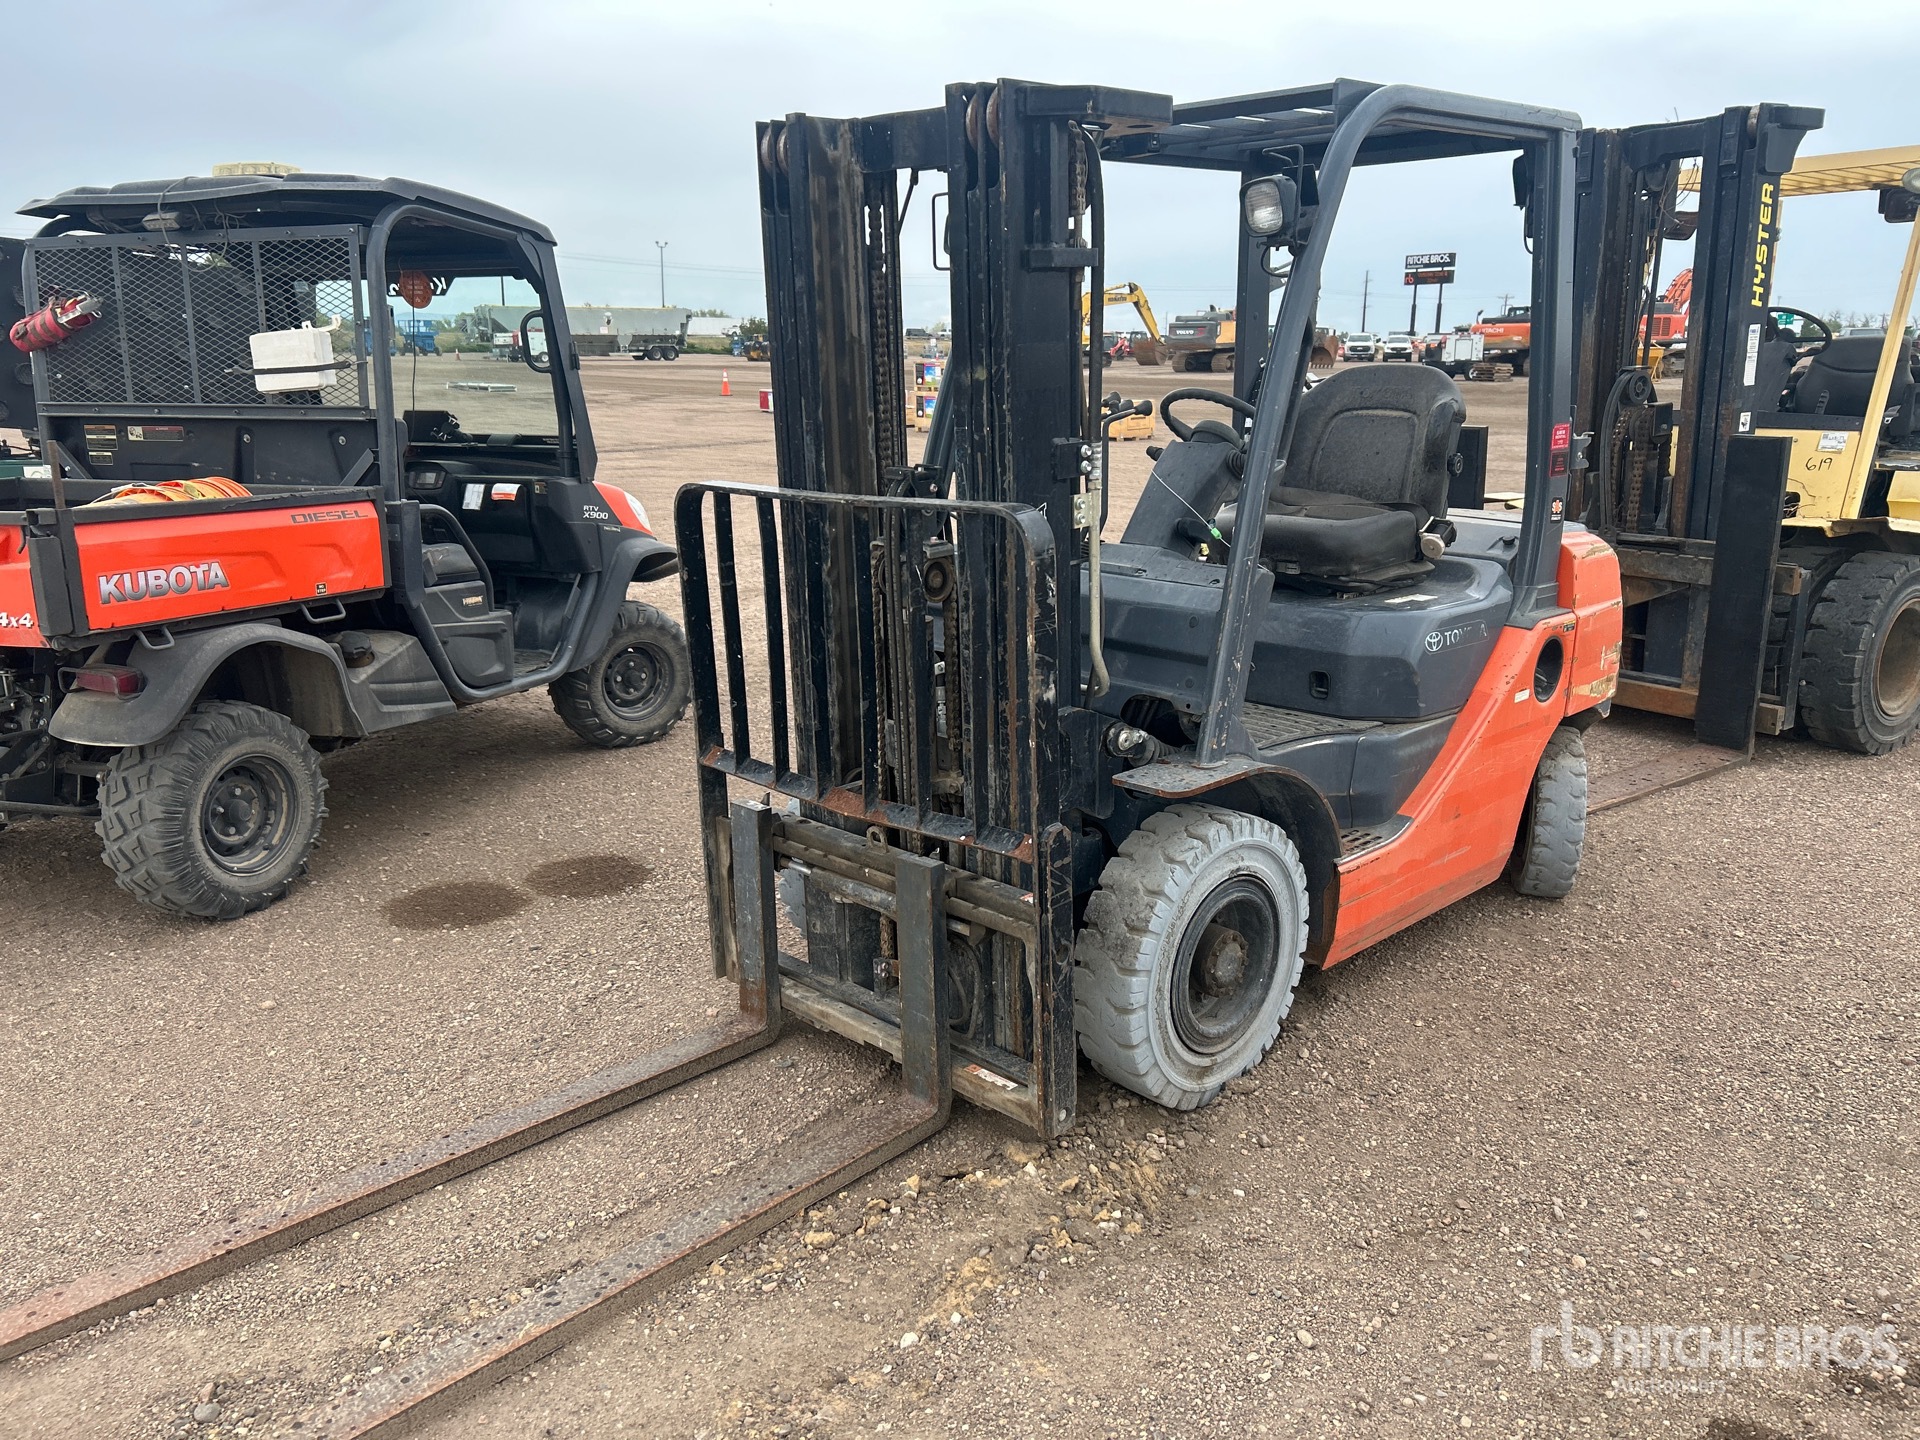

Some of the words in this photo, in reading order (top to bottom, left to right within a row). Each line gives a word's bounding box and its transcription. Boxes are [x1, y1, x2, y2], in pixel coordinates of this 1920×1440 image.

[1751, 182, 1774, 307] HYSTER
[1407, 255, 1429, 264] RITCHIE
[1805, 456, 1833, 471] 619
[290, 509, 369, 524] DIESEL
[583, 511, 608, 520] X900
[98, 561, 230, 604] KUBOTA
[0, 611, 34, 629] 4x4
[1444, 623, 1487, 646] TOA
